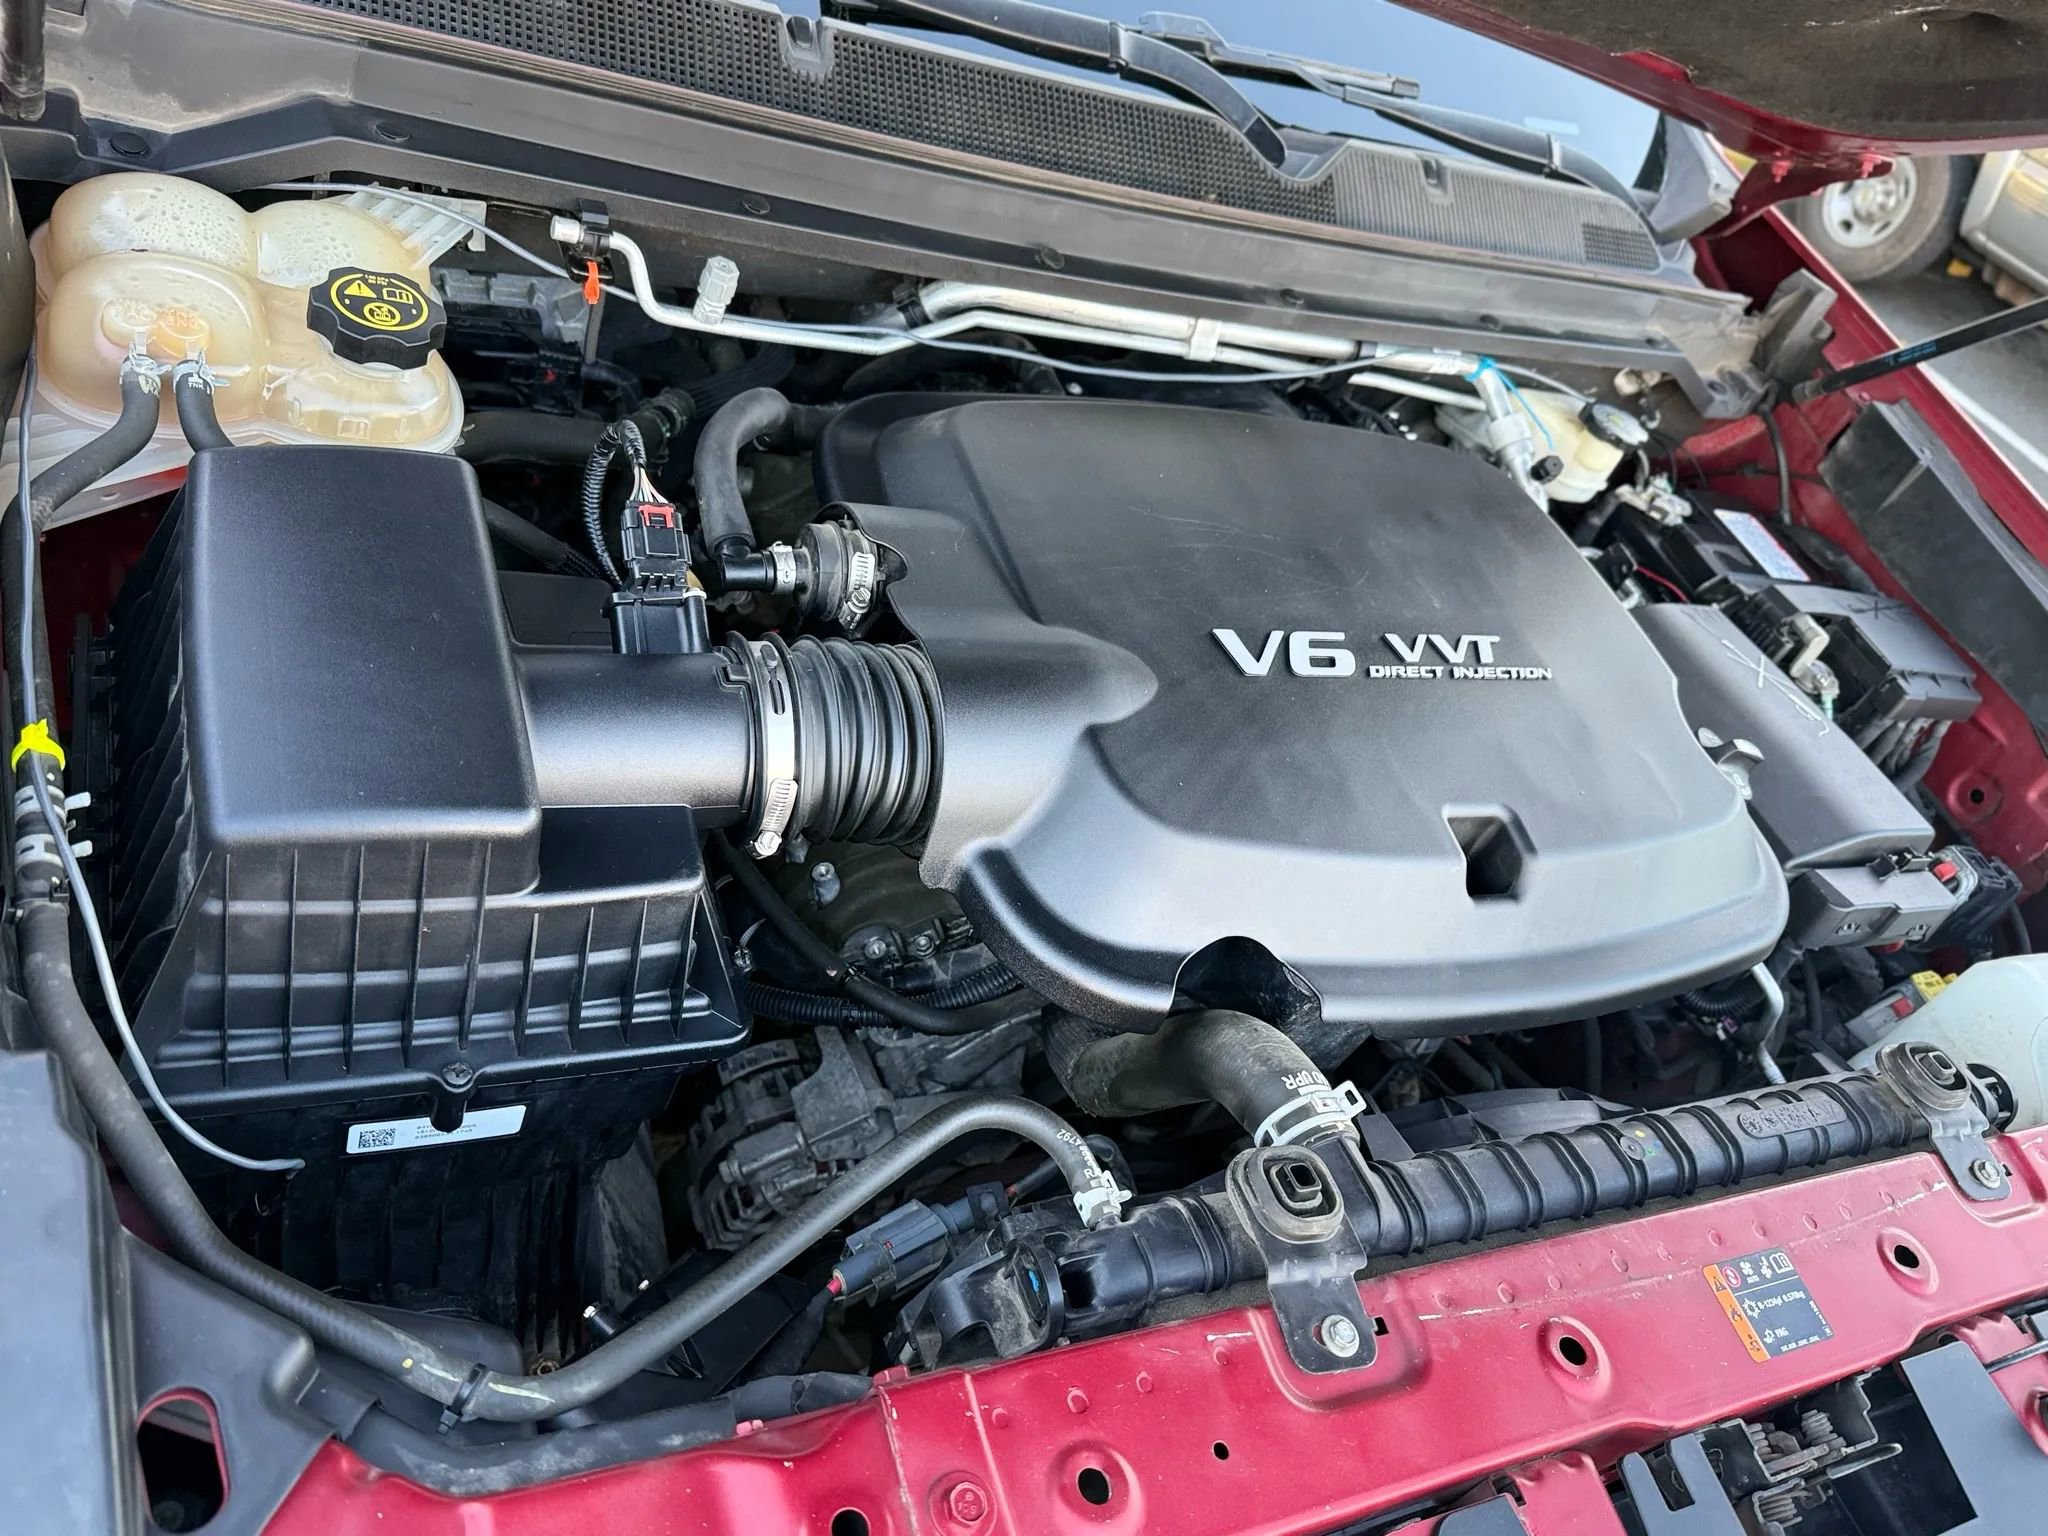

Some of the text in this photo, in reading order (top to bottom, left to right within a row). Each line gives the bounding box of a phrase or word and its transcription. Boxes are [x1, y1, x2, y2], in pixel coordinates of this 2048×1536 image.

[1211, 628, 1501, 677] V6 VVT
[1369, 664, 1553, 680] DIRECT INJECTION
[1280, 1069, 1314, 1090] UPR
